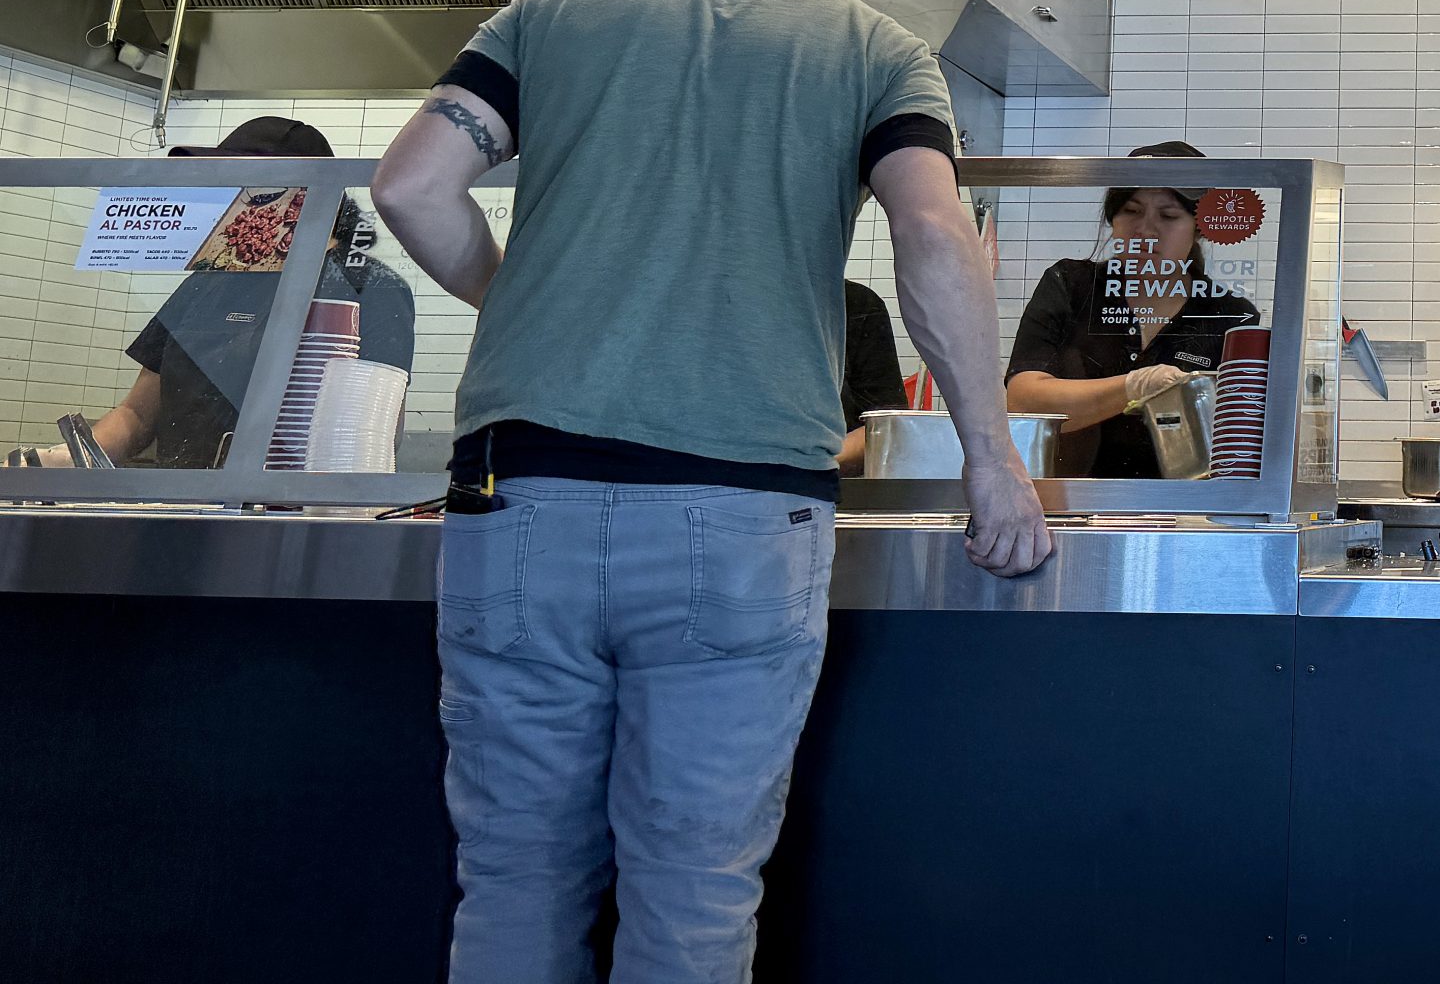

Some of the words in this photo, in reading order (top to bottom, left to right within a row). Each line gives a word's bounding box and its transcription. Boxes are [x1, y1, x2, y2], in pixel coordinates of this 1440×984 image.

[106, 205, 186, 217] CHICKEN
[100, 220, 118, 231] AL
[124, 220, 182, 231] PASTOR
[1111, 239, 1158, 254] GET
[1107, 260, 1193, 275] READY
[1102, 307, 1129, 315] SCAN
[1133, 307, 1153, 315] FOR
